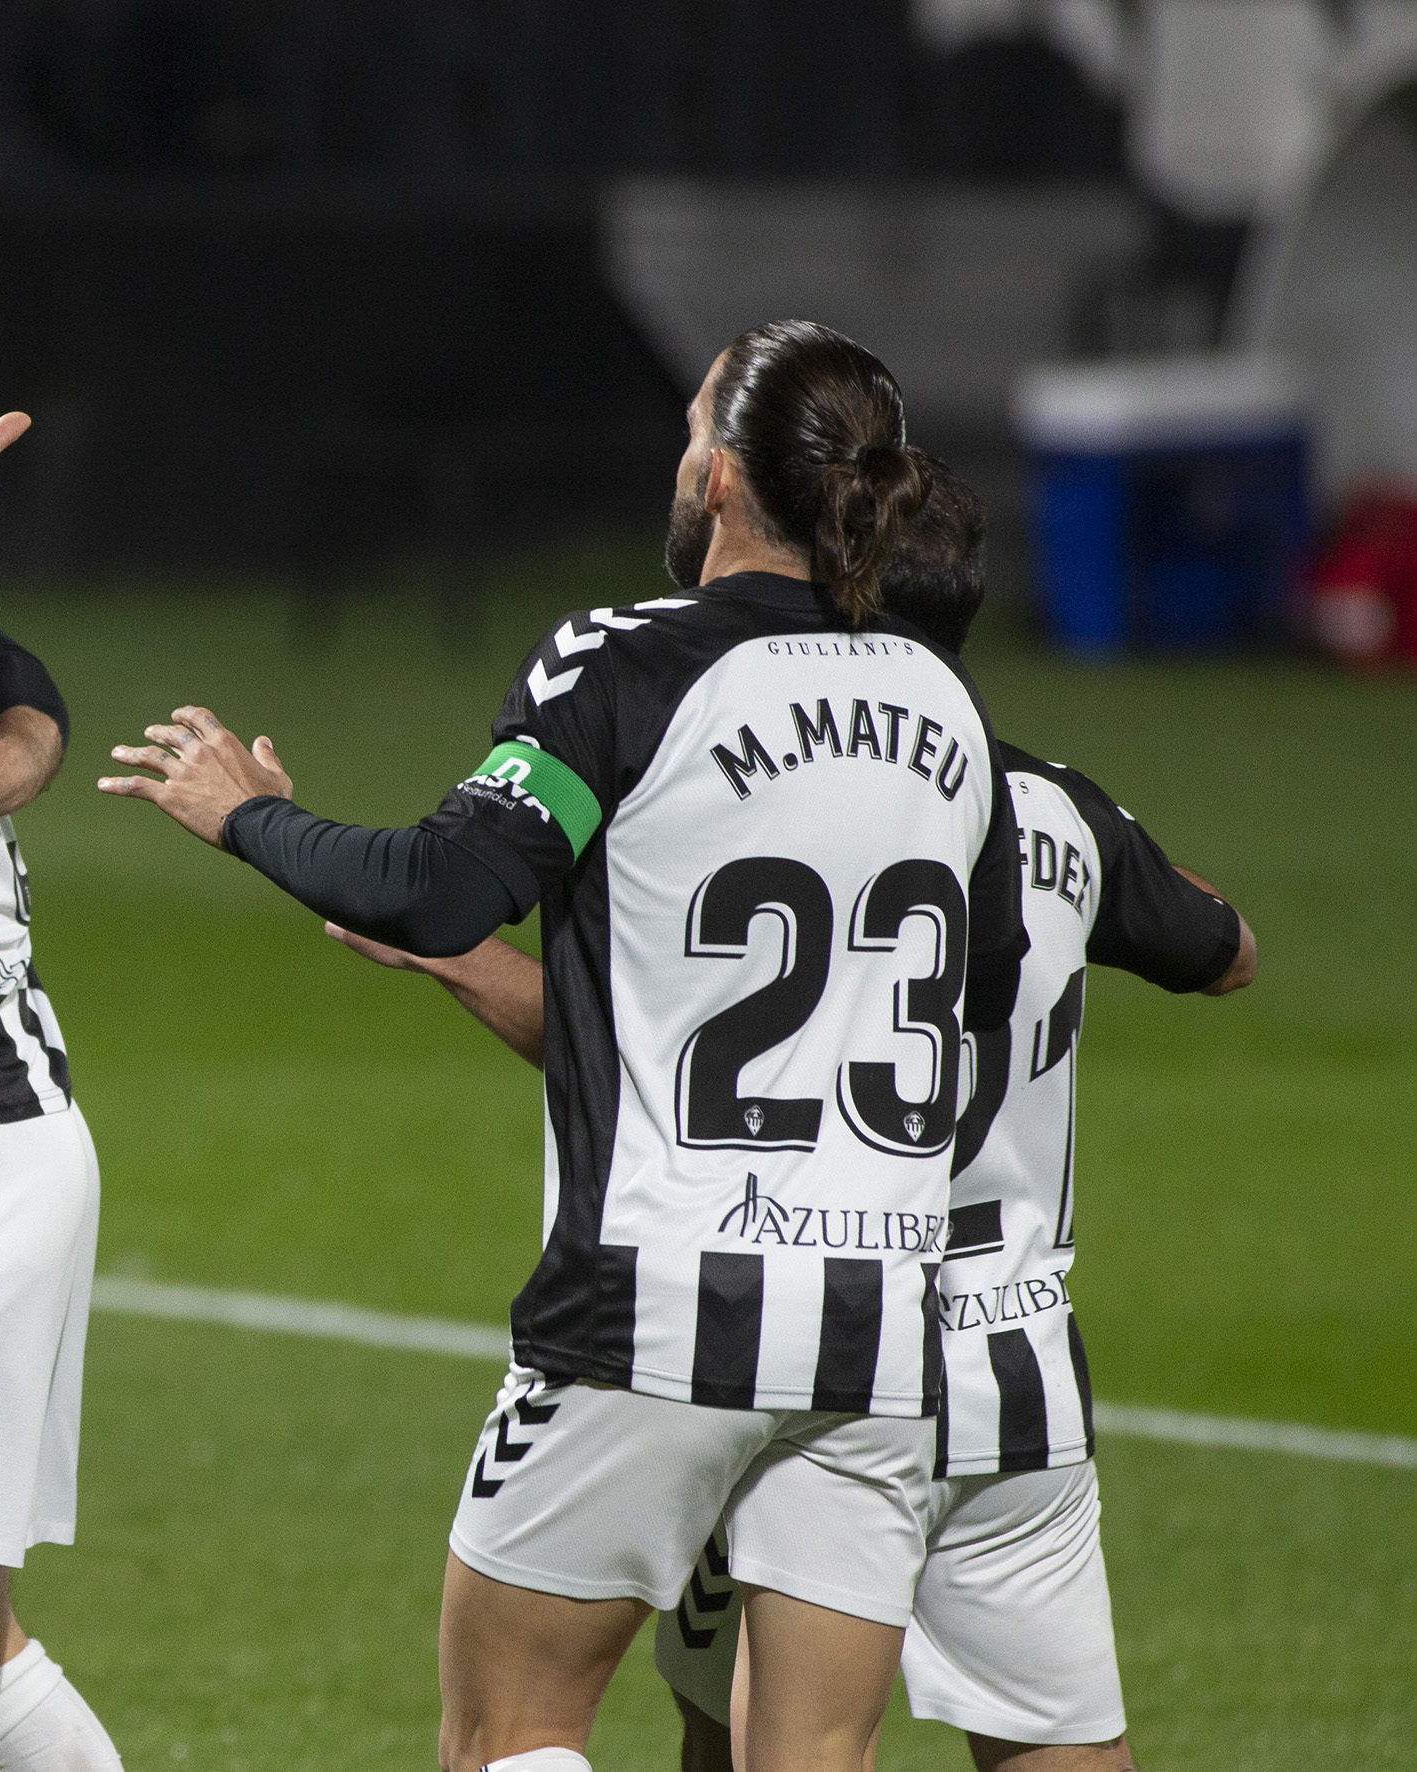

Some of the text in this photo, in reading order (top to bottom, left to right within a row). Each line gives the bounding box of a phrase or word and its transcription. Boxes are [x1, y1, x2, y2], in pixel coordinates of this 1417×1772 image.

[767, 641, 915, 656] GIULIANI'S
[709, 697, 968, 802] M.MATEU
[674, 856, 969, 1159] 23
